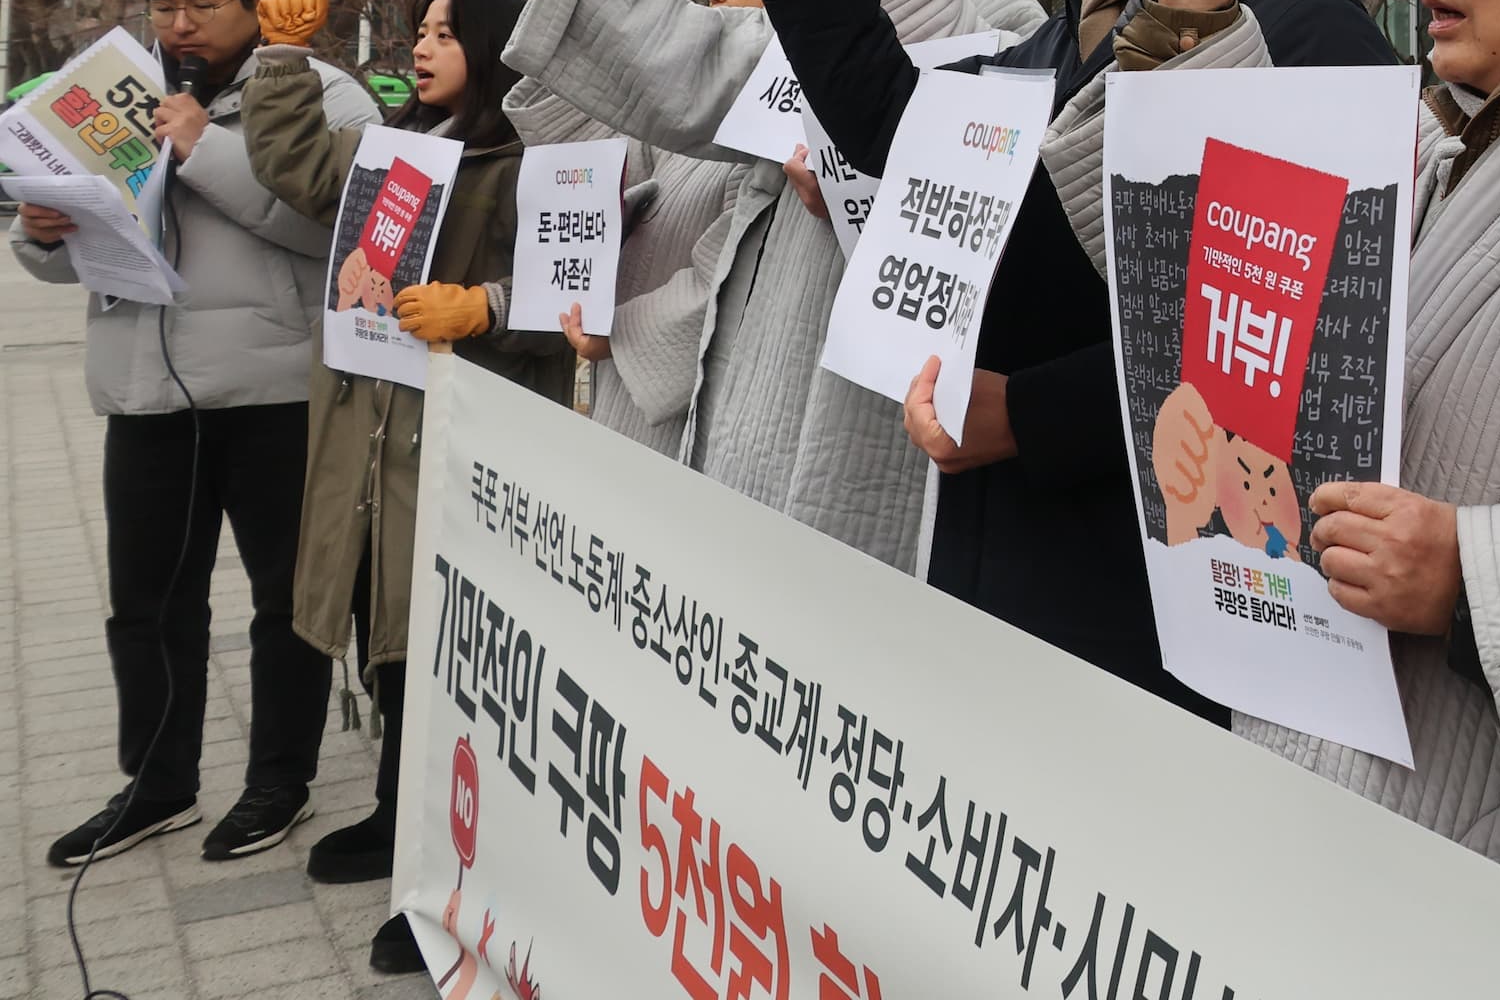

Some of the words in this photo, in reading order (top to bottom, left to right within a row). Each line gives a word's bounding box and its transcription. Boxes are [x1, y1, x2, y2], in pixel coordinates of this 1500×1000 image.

[106, 74, 161, 151] 5천
[759, 76, 803, 114] 시정
[963, 121, 1020, 166] coupang
[47, 158, 73, 176] 네
[556, 168, 593, 189] coupang
[388, 180, 421, 212] coupang
[900, 177, 995, 253] 적반하장
[1115, 188, 1134, 216] 쿠팡
[1343, 196, 1384, 225] 산재
[371, 210, 406, 257] 거부!
[538, 210, 606, 243] 돈·편리보다
[1145, 222, 1178, 249] 초저가
[1345, 230, 1382, 266] 입점
[1207, 201, 1317, 271] coupang
[551, 258, 592, 291] 자존심
[1118, 254, 1143, 285] 업체
[1203, 246, 1242, 277] 기만적인
[1244, 262, 1263, 285] 5천
[1265, 270, 1277, 290] 원
[1279, 276, 1304, 300] 쿠폰
[1121, 291, 1144, 320] 검색
[1316, 314, 1352, 340] 자사
[1360, 316, 1380, 344] 상
[1123, 325, 1133, 356] 품
[1136, 329, 1159, 358] 상위
[1201, 283, 1293, 398] 거부!
[1300, 386, 1322, 421] 업
[1353, 432, 1373, 468] 입
[472, 461, 498, 533] 쿠폰
[501, 482, 530, 556] 거부
[533, 501, 566, 585] 선언
[1211, 558, 1241, 588] 탈팡!
[1243, 567, 1265, 595] 쿠폰
[1264, 572, 1293, 602] 거부!
[1214, 587, 1249, 619] 쿠팡은
[1250, 597, 1297, 632] 들어라!
[433, 553, 546, 796] 기만적인
[547, 667, 627, 897] 쿠팡
[638, 754, 790, 1000] 5천원
[455, 775, 473, 829] NO
